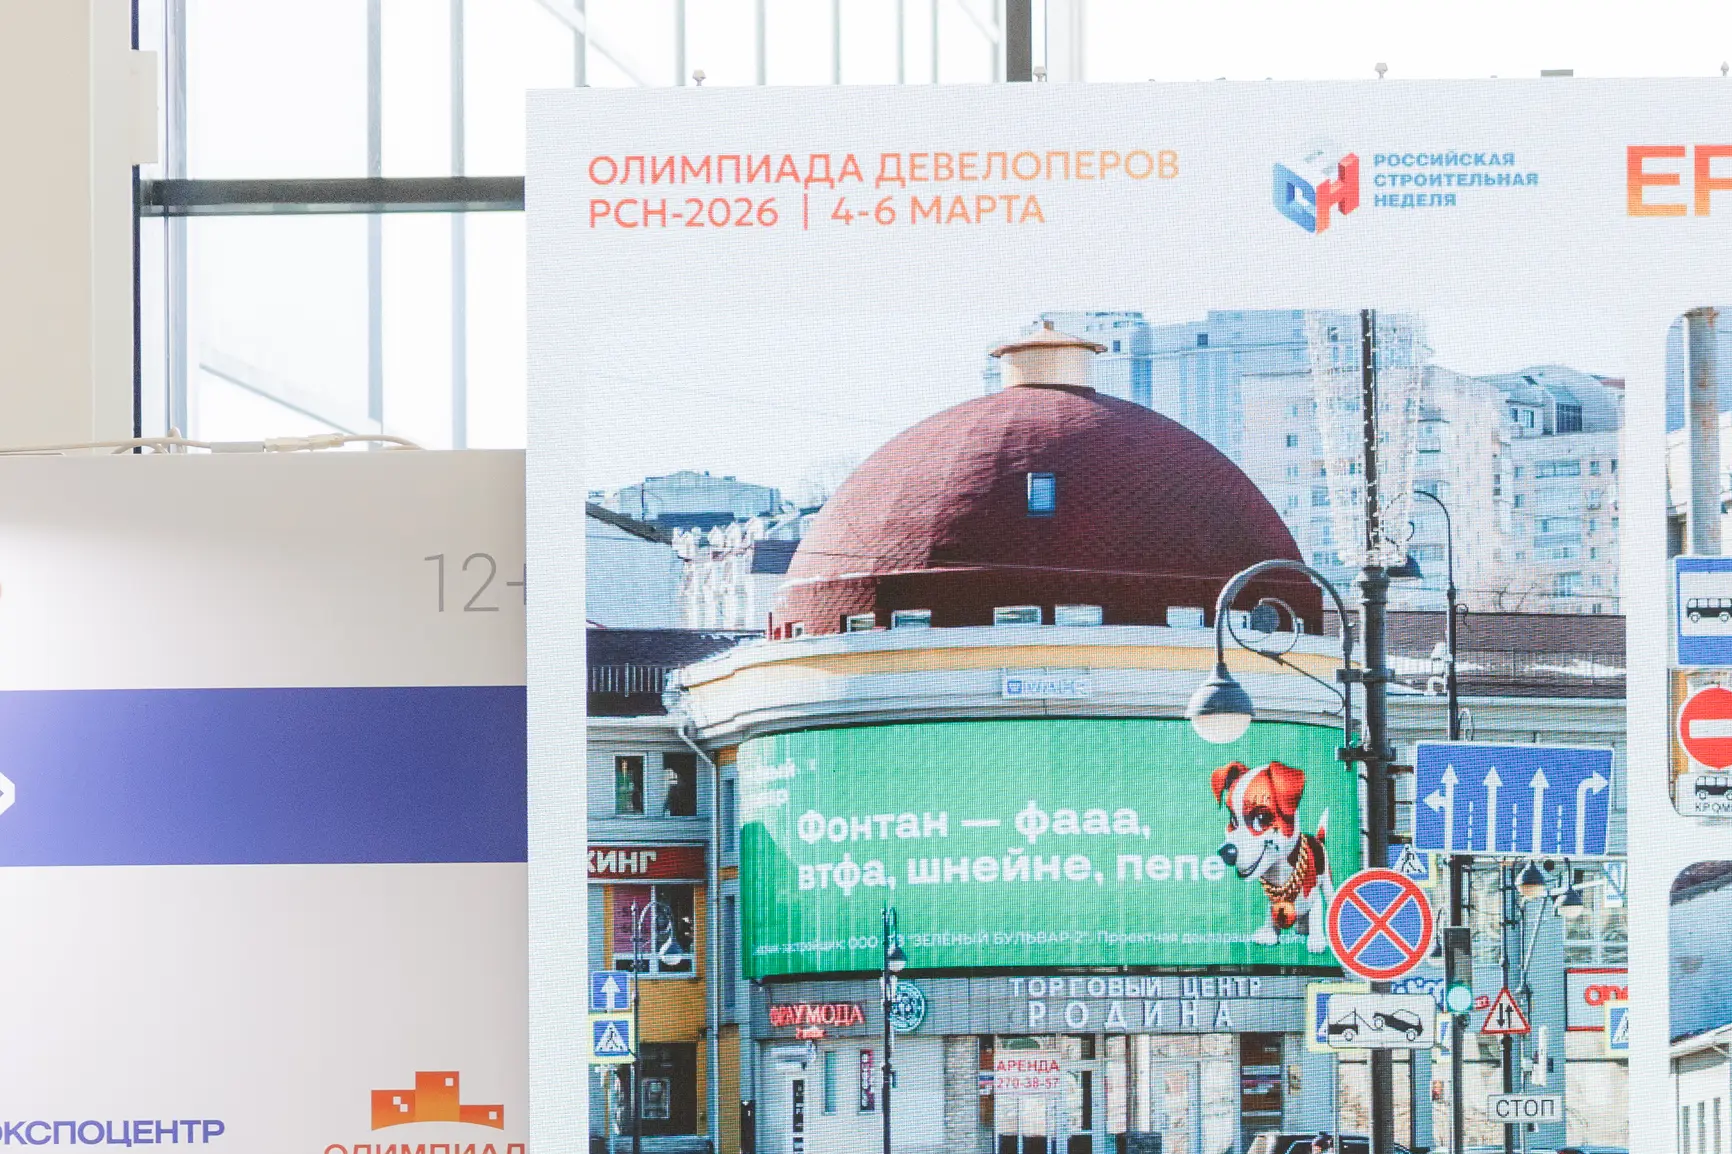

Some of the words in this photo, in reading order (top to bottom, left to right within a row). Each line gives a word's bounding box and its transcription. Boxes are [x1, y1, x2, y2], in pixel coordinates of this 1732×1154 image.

[587, 154, 864, 189] ОЛИМПИАДА
[876, 149, 1180, 186] ДЕВЕЛОПЕРОВ
[1374, 150, 1516, 167] РОССИЙСКАЯ
[1374, 173, 1539, 187] СТРОИТЕЛЬНАЯ
[589, 197, 779, 229] РСН-2026
[831, 196, 897, 225] 4-6
[910, 194, 1045, 225] МАРТА
[1374, 193, 1457, 208] НЕДЕЛЯ
[797, 807, 948, 845] Фонтан
[1014, 801, 1151, 844] фааа,
[797, 853, 897, 897] втфа,
[906, 847, 1103, 886] шнейне,
[1116, 854, 1226, 882] пепе
[1009, 978, 1162, 998] ТОРГОВЫЙ
[1182, 977, 1261, 1000] ЦЕНТР
[1028, 1000, 1234, 1030] РОДИНА
[996, 1060, 1060, 1072] АРЕНДА
[1496, 1099, 1555, 1118] СТОП
[0, 1119, 226, 1147] КСПОЦЕНТР
